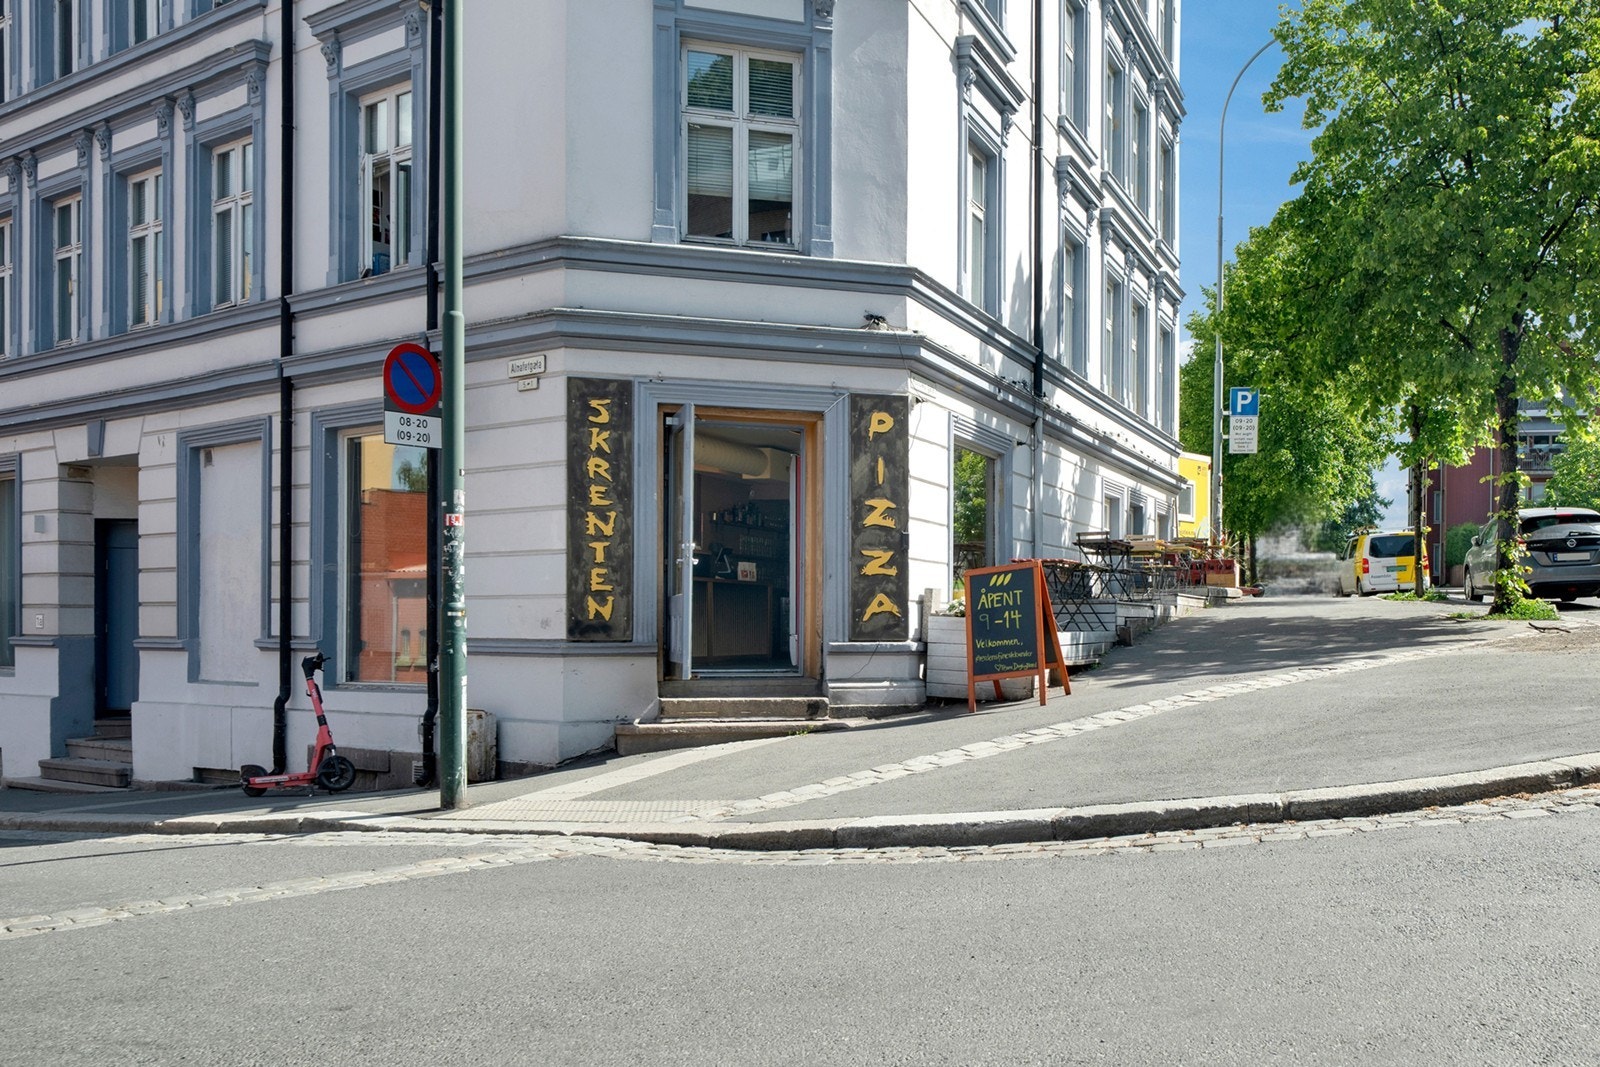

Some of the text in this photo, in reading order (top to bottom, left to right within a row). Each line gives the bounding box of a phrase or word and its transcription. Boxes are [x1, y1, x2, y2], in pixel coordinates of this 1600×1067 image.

[1237, 391, 1252, 413] P
[399, 416, 428, 429] 08-20
[397, 429, 431, 443] (09-20)
[585, 399, 617, 621] SKRENTEN
[861, 411, 902, 622] PIZZA
[978, 588, 1023, 610] ÅPENT
[976, 639, 1023, 649] Velkommen,
